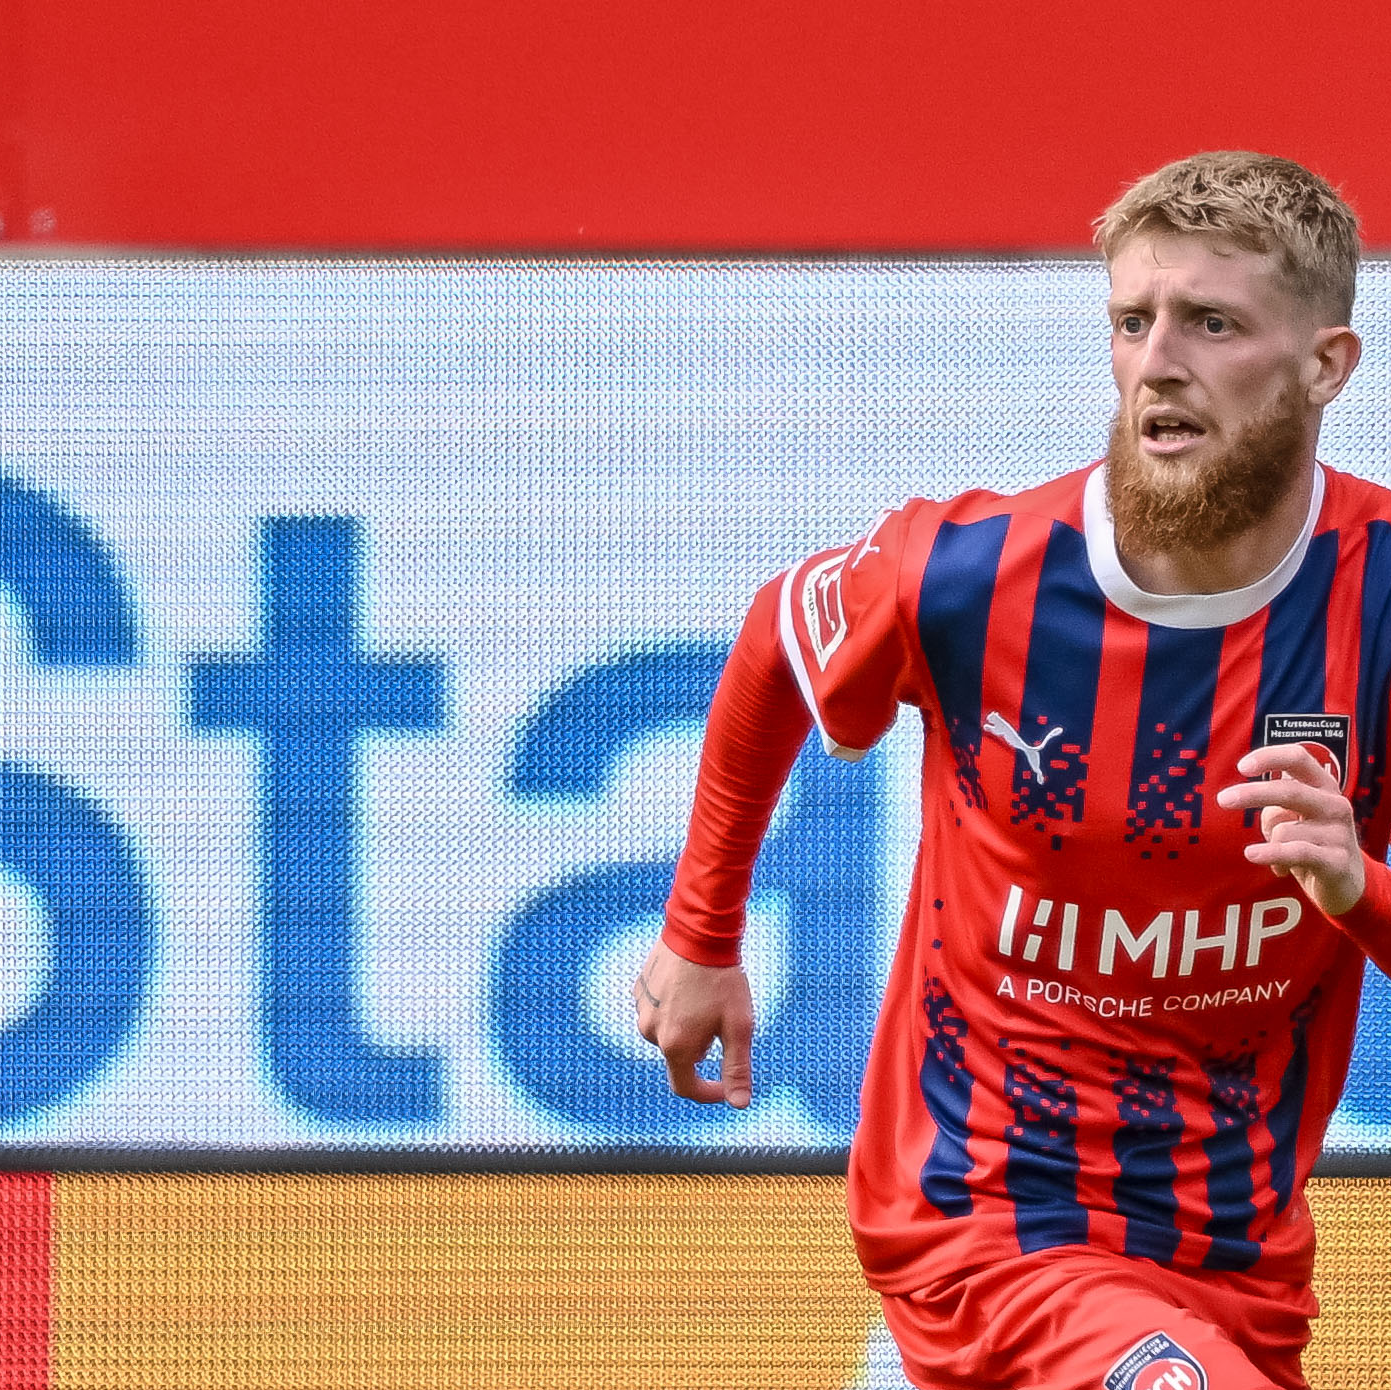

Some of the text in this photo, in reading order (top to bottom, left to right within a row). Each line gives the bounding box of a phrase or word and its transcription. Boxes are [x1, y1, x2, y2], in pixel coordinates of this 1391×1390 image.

[1098, 896, 1302, 979] MHP
[997, 976, 1291, 1019] A PORSCHE COMPANY
